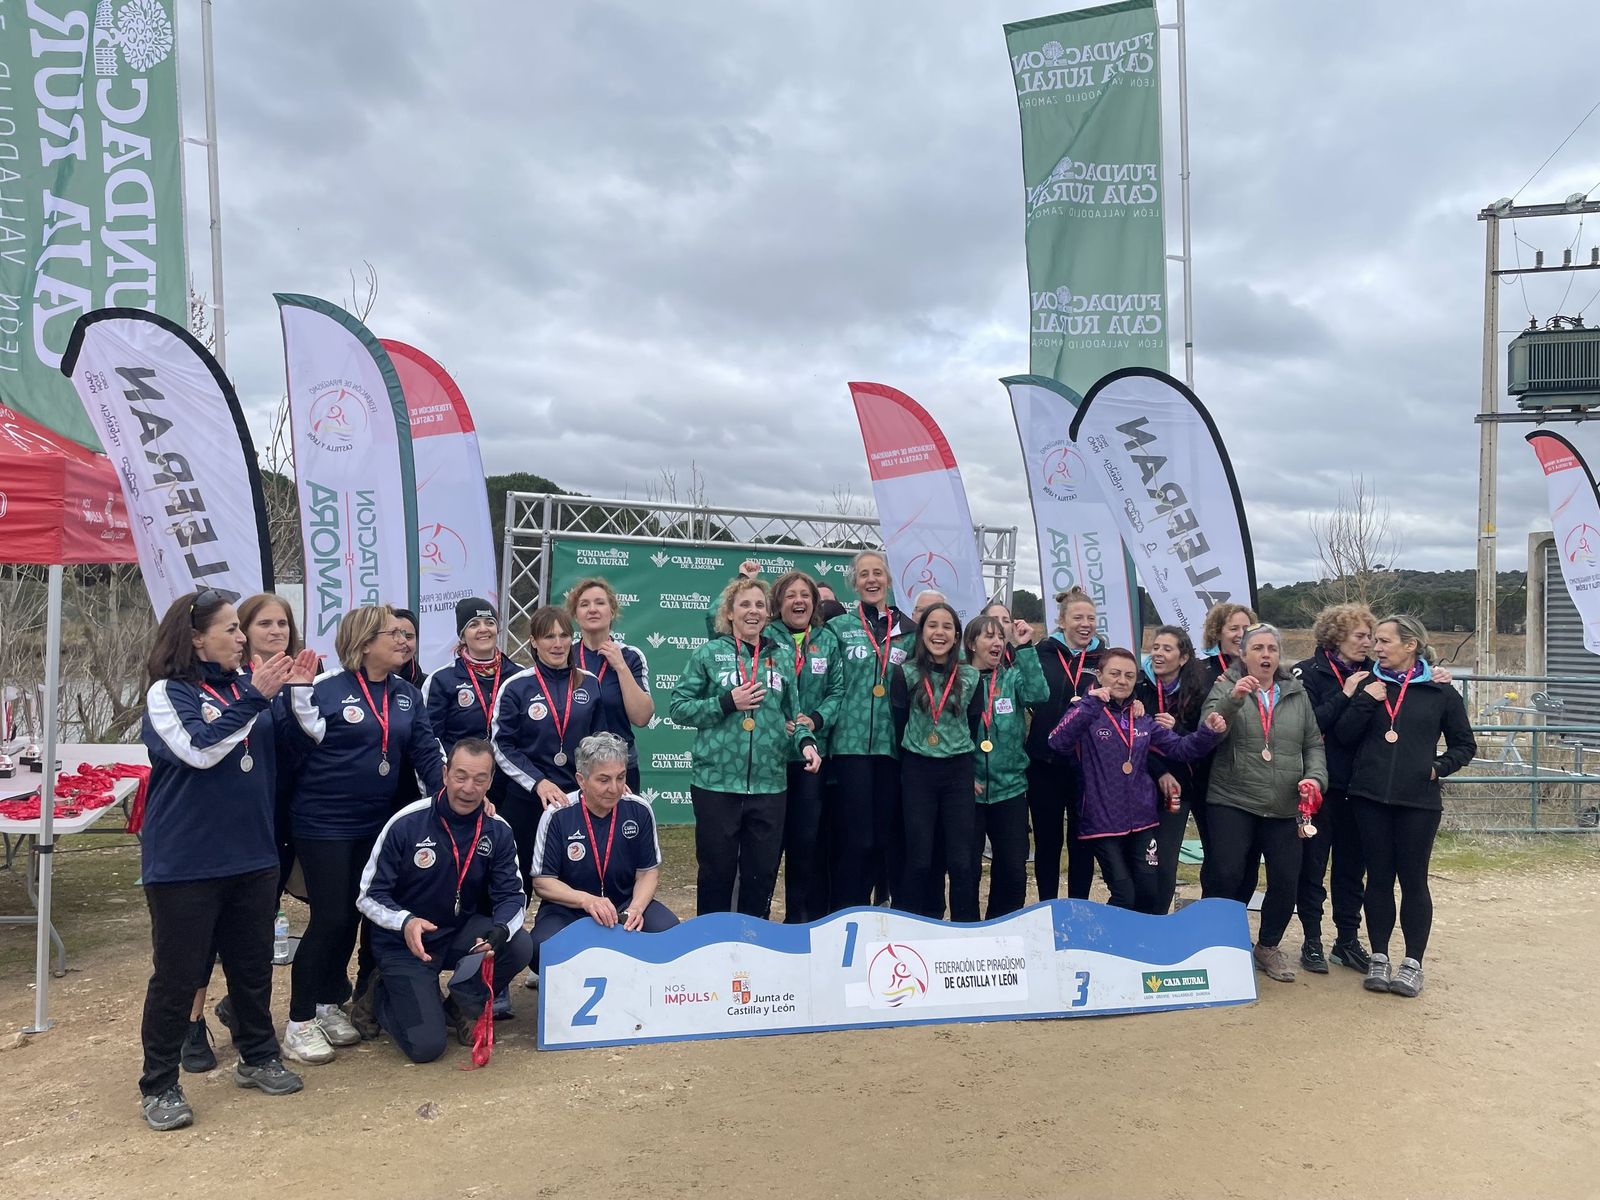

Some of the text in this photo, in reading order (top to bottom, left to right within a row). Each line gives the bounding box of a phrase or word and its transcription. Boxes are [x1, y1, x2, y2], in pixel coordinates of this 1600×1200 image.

[577, 557, 629, 566] CAJA RURAL
[671, 556, 724, 566] CAJA RURAL
[767, 566, 793, 575] RURAL
[616, 594, 640, 602] URAL
[660, 601, 680, 609] CAJA
[667, 637, 689, 645] CAJA
[845, 645, 868, 660] 76
[661, 791, 682, 799] CAJA
[842, 922, 858, 967] 1
[935, 956, 1025, 973] FEDERACIÓN DE PIRAGÜISMO
[945, 970, 1018, 989] DE CASTILLA Y LEÓN
[1163, 977, 1206, 986] CAJA RURAL
[664, 984, 686, 993] NOS
[1072, 971, 1090, 1007] 3
[571, 977, 607, 1026] 2
[754, 992, 795, 1003] Junta de
[727, 1003, 795, 1016] Castilla y León
